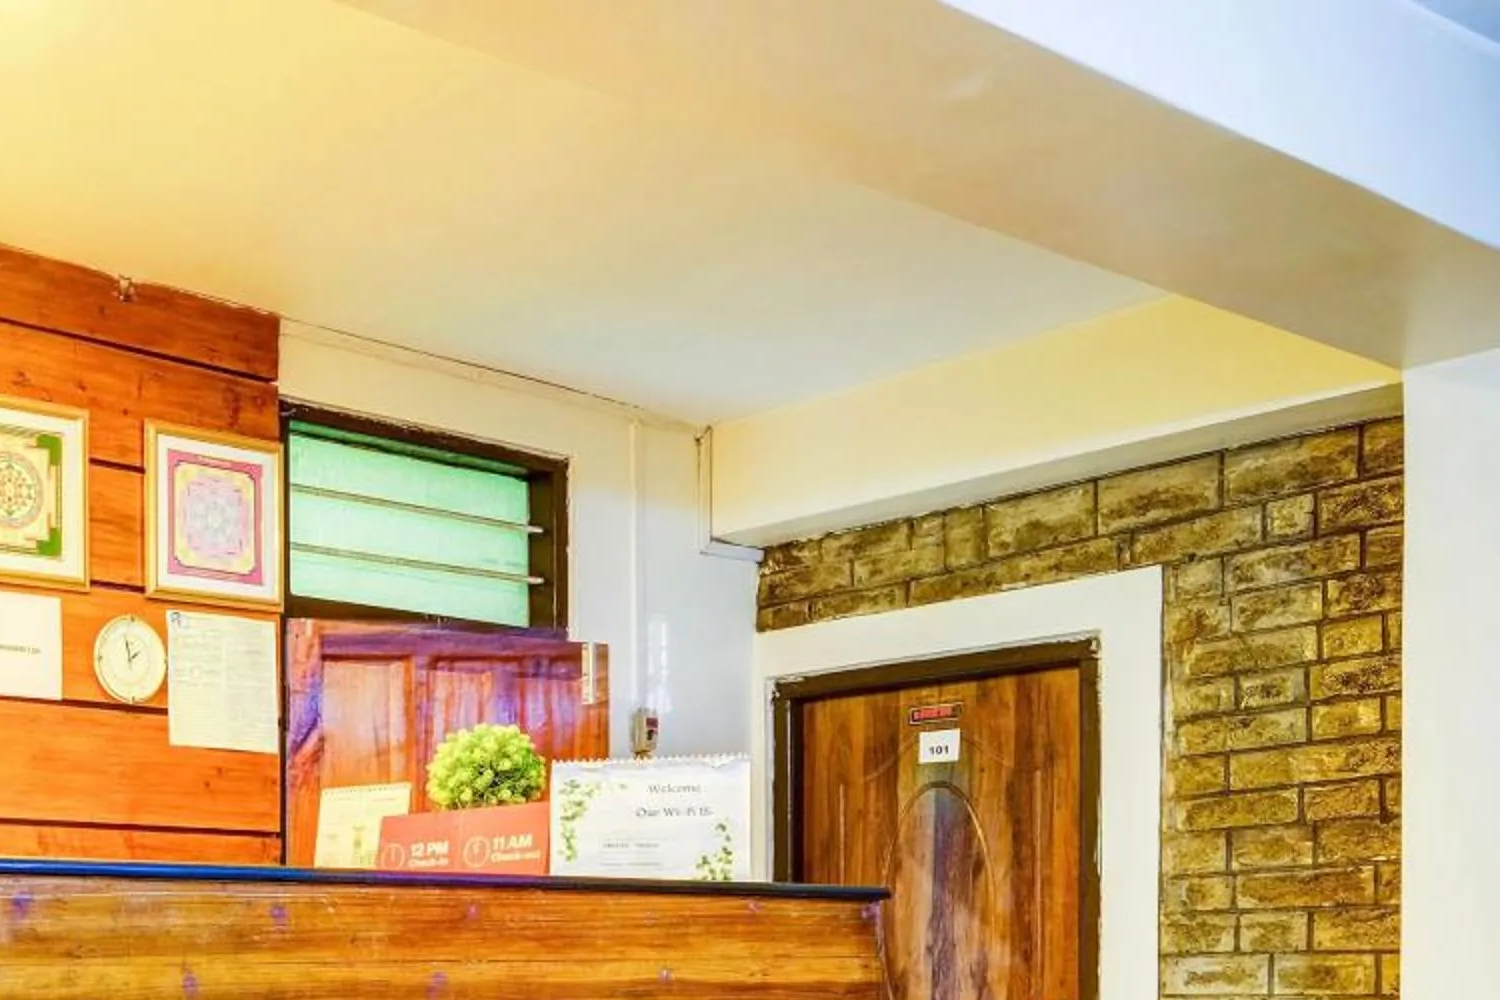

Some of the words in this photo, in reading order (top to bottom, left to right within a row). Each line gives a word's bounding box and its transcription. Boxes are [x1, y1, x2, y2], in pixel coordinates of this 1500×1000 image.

[929, 745, 949, 755] 101
[427, 840, 449, 856] PM
[506, 833, 534, 849] AM
